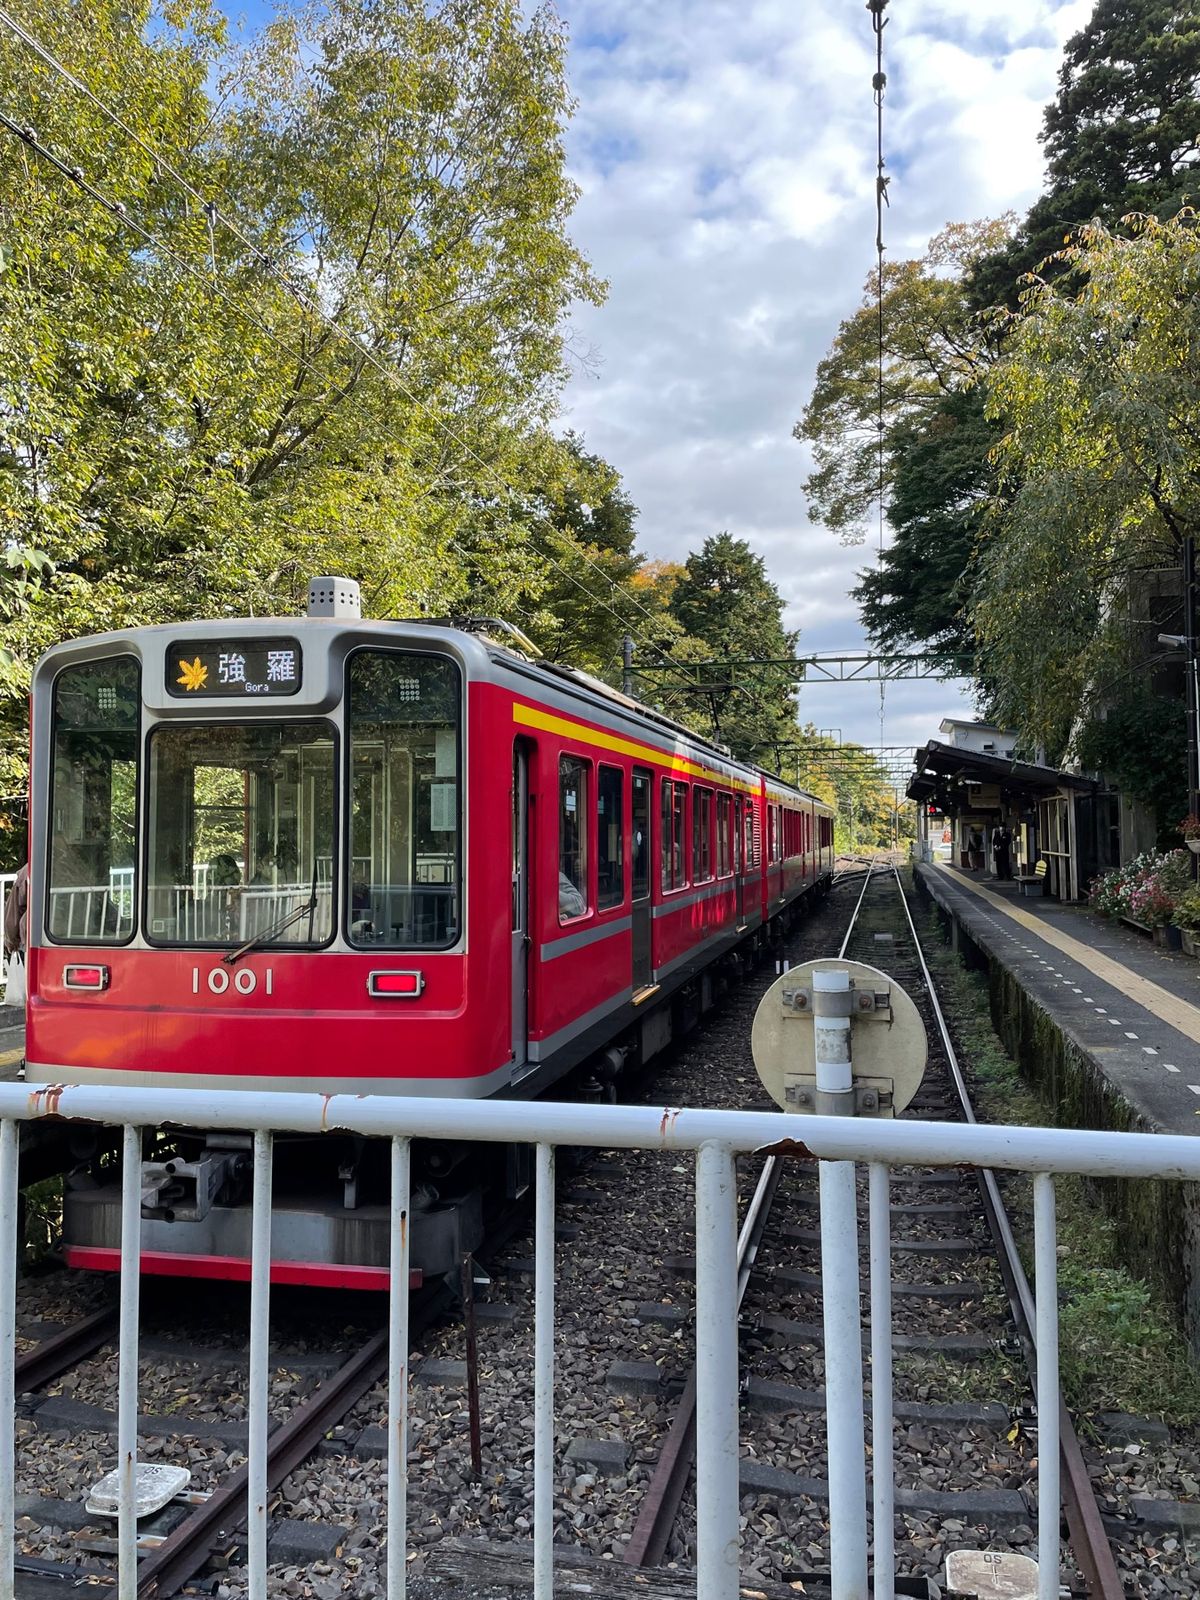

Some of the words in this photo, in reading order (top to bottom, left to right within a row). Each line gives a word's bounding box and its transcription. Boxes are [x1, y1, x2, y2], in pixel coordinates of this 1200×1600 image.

[218, 650, 295, 683] 強羅
[245, 682, 269, 692] Gora
[192, 967, 272, 995] 1001
